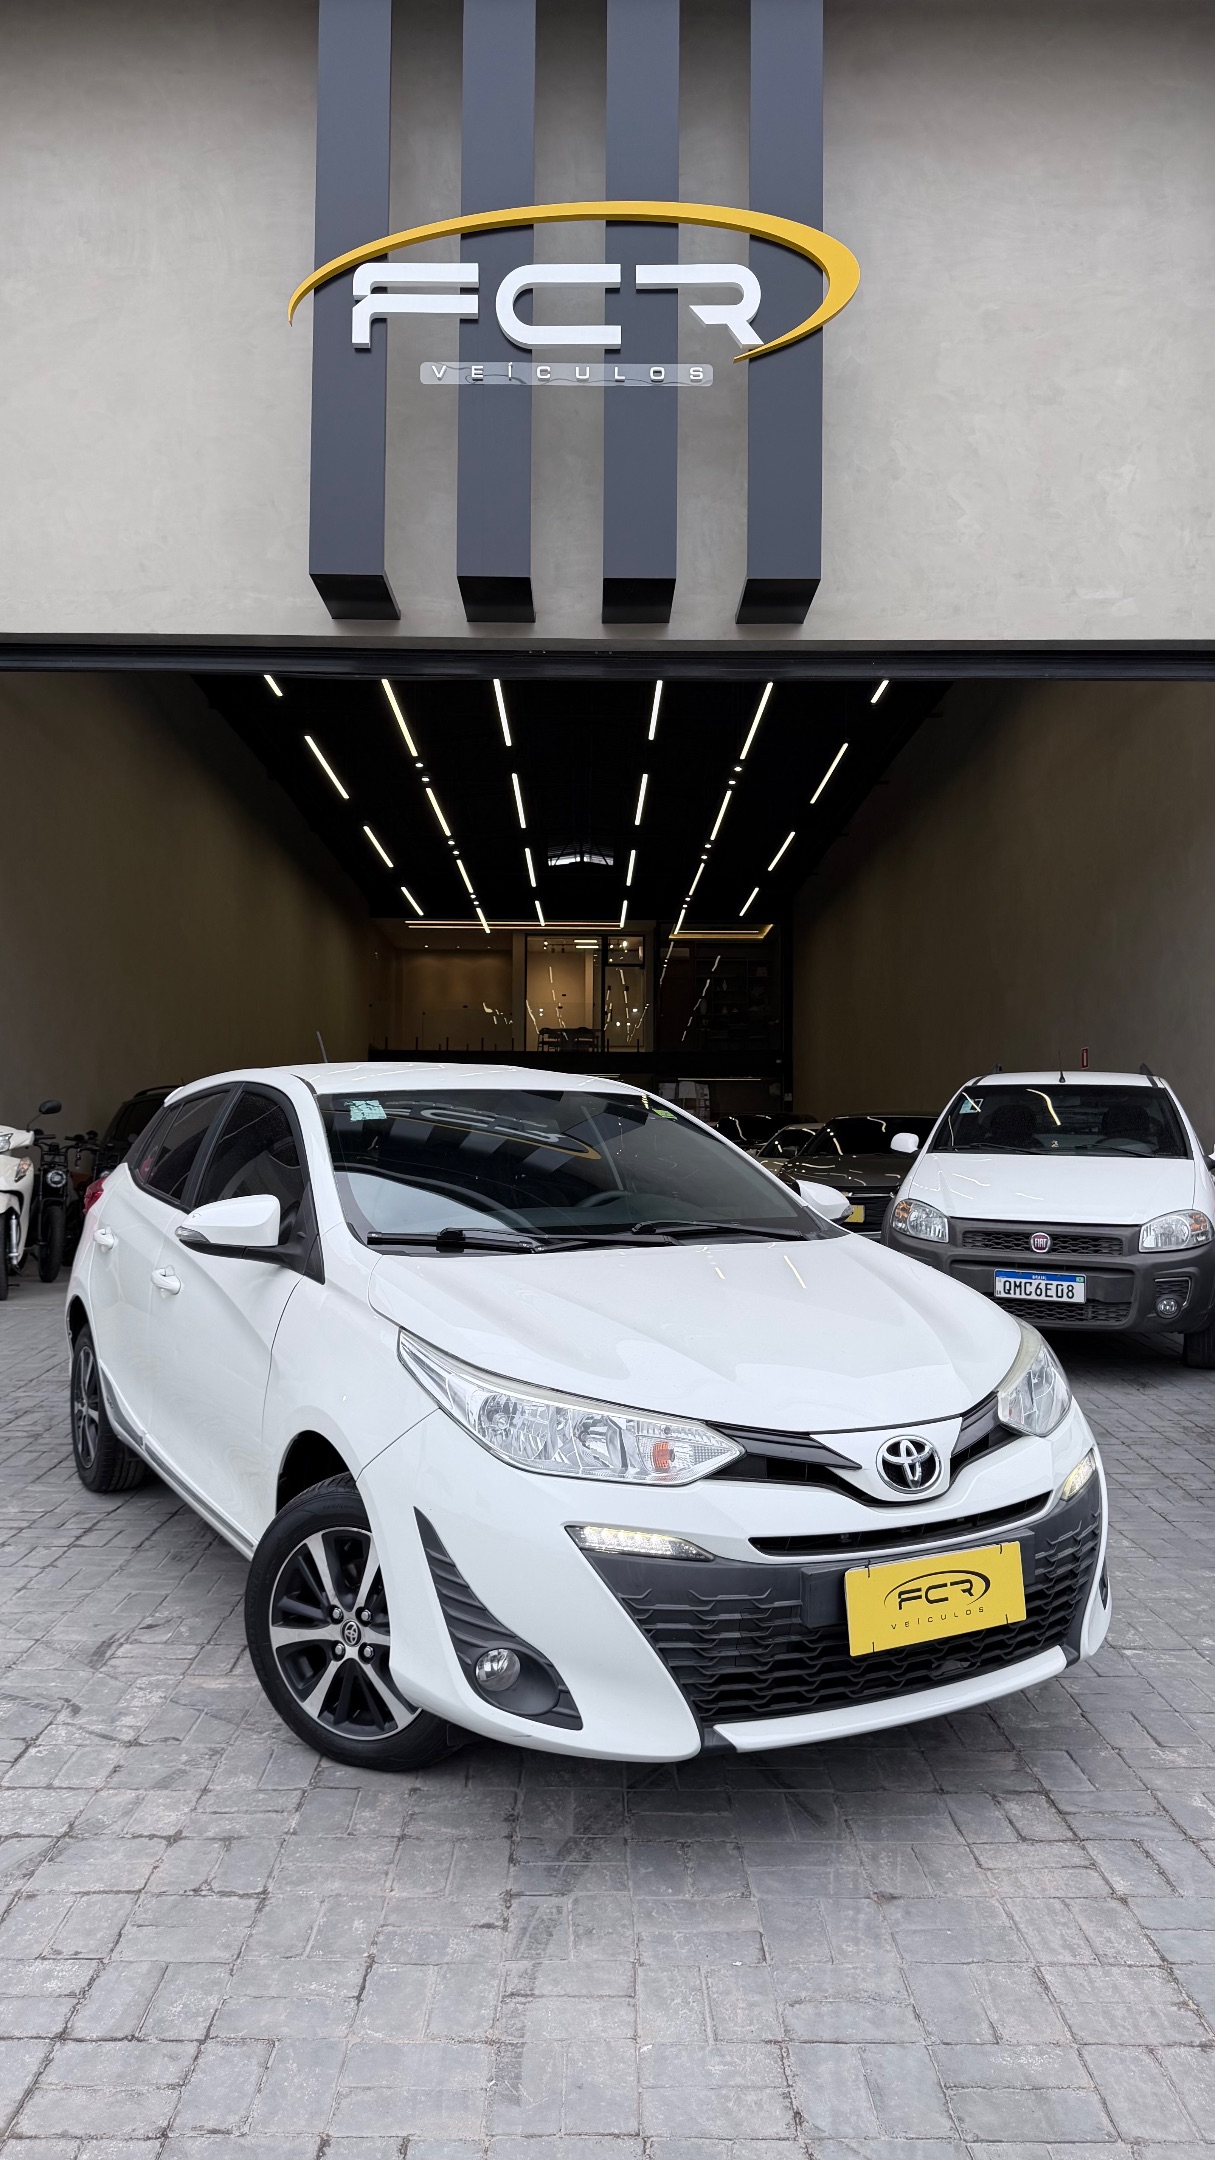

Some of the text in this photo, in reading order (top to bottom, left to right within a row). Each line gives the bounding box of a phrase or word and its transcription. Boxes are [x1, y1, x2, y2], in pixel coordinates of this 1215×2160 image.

[352, 263, 764, 348] FCR
[432, 362, 703, 381] VEÍCULOS
[1035, 1239, 1047, 1248] FIAT
[1003, 1280, 1074, 1299] QMC6E08
[898, 1579, 974, 1610] FCR
